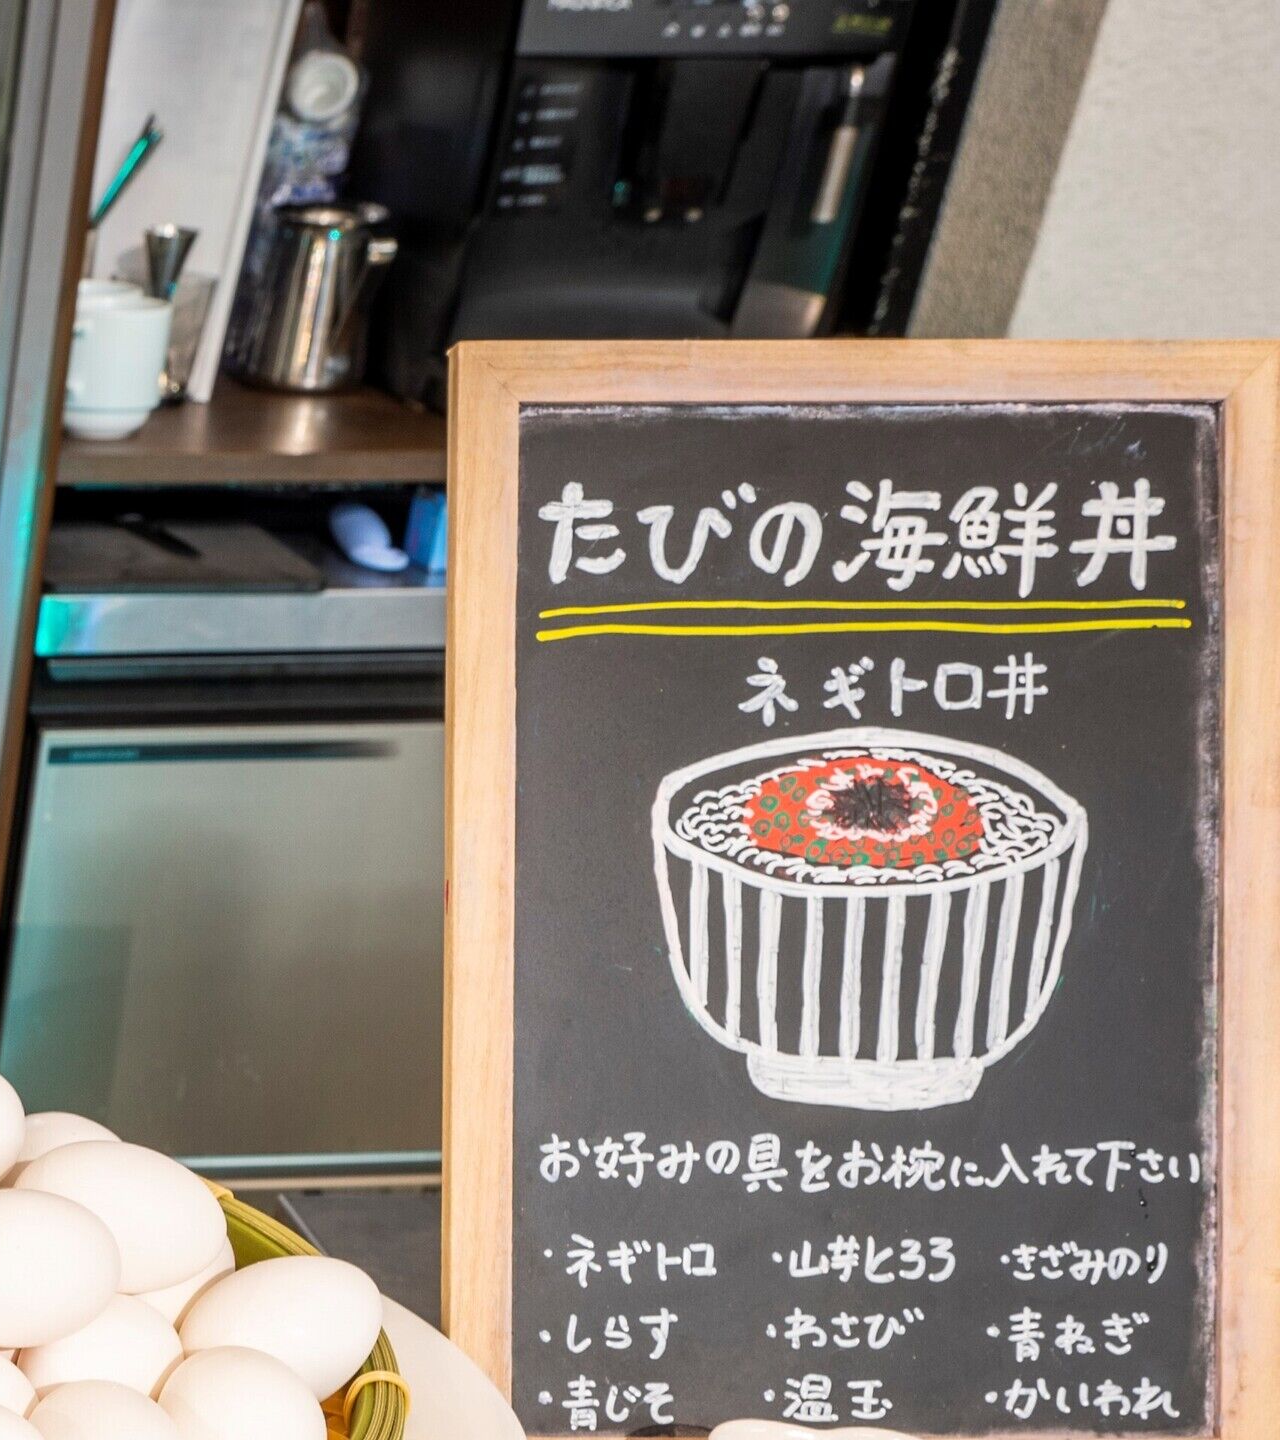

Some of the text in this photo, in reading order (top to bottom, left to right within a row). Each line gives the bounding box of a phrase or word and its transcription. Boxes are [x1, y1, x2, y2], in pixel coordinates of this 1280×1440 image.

[538, 478, 1177, 598] たびの海鮮丼
[738, 652, 1048, 726] ネギトロ丼
[539, 1131, 1200, 1193] お好みの具をお椀に入れて下さい
